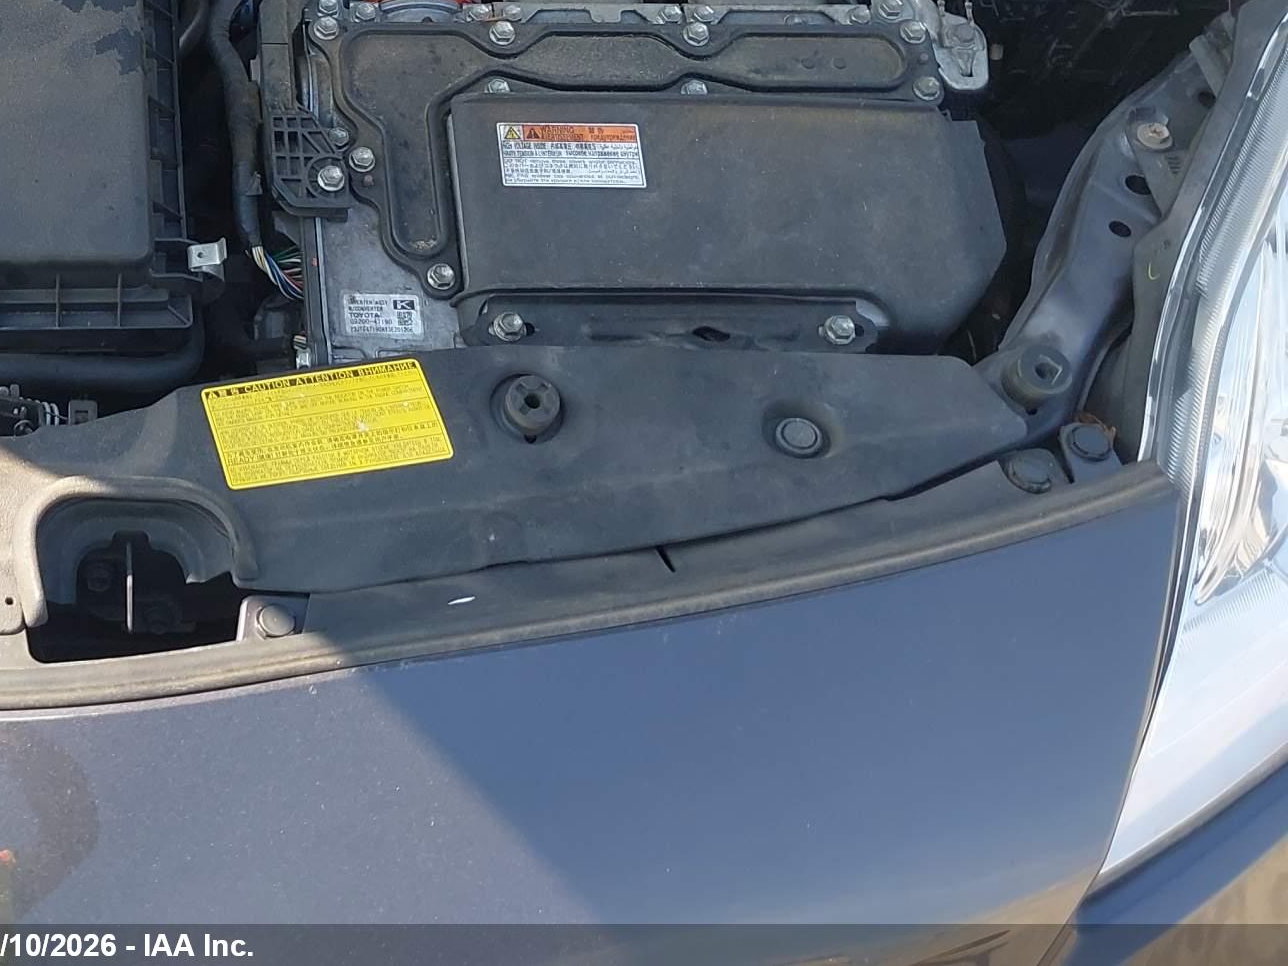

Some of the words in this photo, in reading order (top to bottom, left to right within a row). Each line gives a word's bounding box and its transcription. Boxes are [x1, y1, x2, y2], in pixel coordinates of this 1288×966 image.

[541, 126, 575, 134] WARNING
[395, 299, 413, 310] K
[244, 379, 290, 393] CAUTION
[296, 370, 354, 386] ATTENTION
[358, 362, 414, 377] ВНИМАНИЕ
